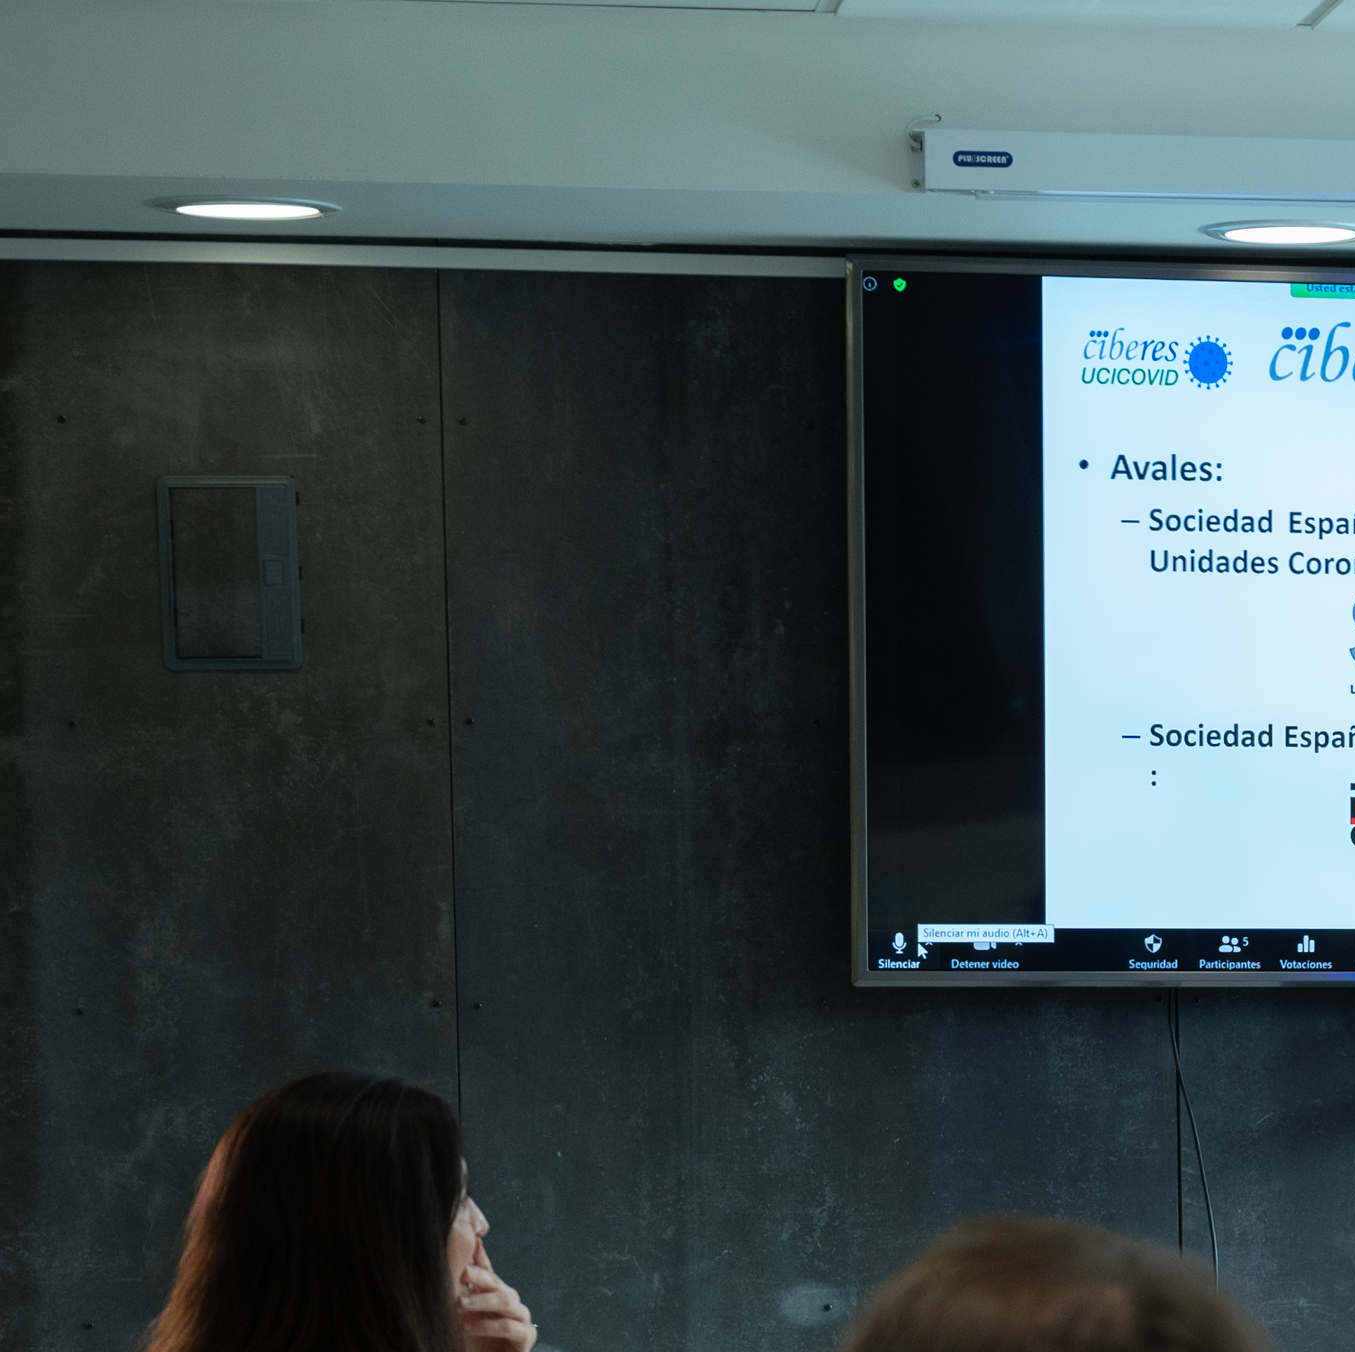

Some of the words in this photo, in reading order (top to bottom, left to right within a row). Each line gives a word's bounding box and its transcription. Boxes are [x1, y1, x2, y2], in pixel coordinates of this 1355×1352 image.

[1306, 284, 1336, 292] Usted
[1081, 367, 1180, 386] UCICOVID
[1110, 455, 1224, 482] Avales:
[1148, 509, 1274, 534] Sociedad
[1149, 550, 1280, 576] Unidades
[1149, 724, 1274, 748] Sociedad
[923, 928, 964, 938] Silenciar
[968, 928, 978, 938] mi
[980, 928, 1009, 939] audio
[1012, 929, 1048, 940] (Alt+A)
[878, 959, 920, 970] Silenciar
[951, 959, 990, 970] Detener
[991, 959, 1020, 970] video
[1199, 959, 1261, 970] Participantes
[1280, 960, 1332, 970] Votaciones
